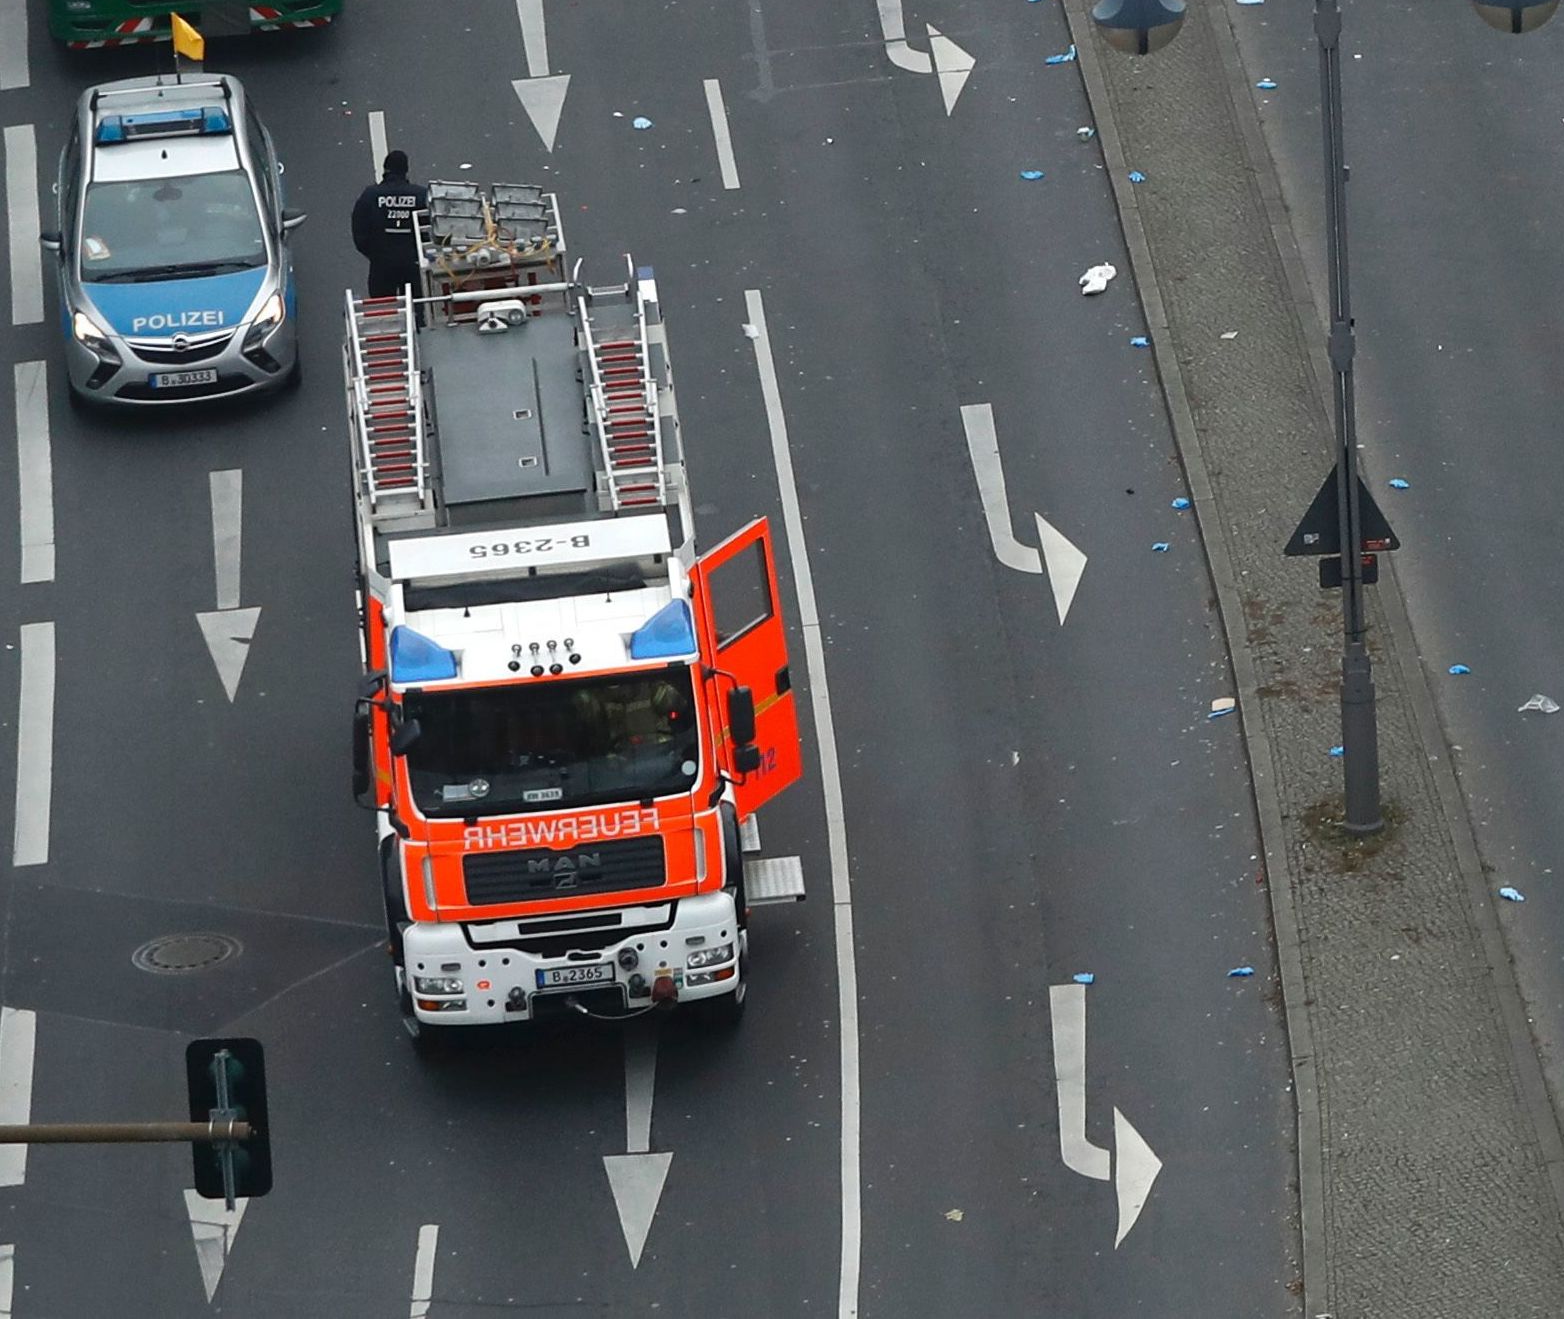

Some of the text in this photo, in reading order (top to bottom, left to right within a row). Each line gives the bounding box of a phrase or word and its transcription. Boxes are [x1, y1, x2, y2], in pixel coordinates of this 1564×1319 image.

[378, 196, 416, 208] POLIZEI
[132, 310, 224, 332] POLIZEI
[469, 535, 591, 559] B-2365
[527, 852, 600, 873] MAN
[569, 967, 603, 982] 2365
